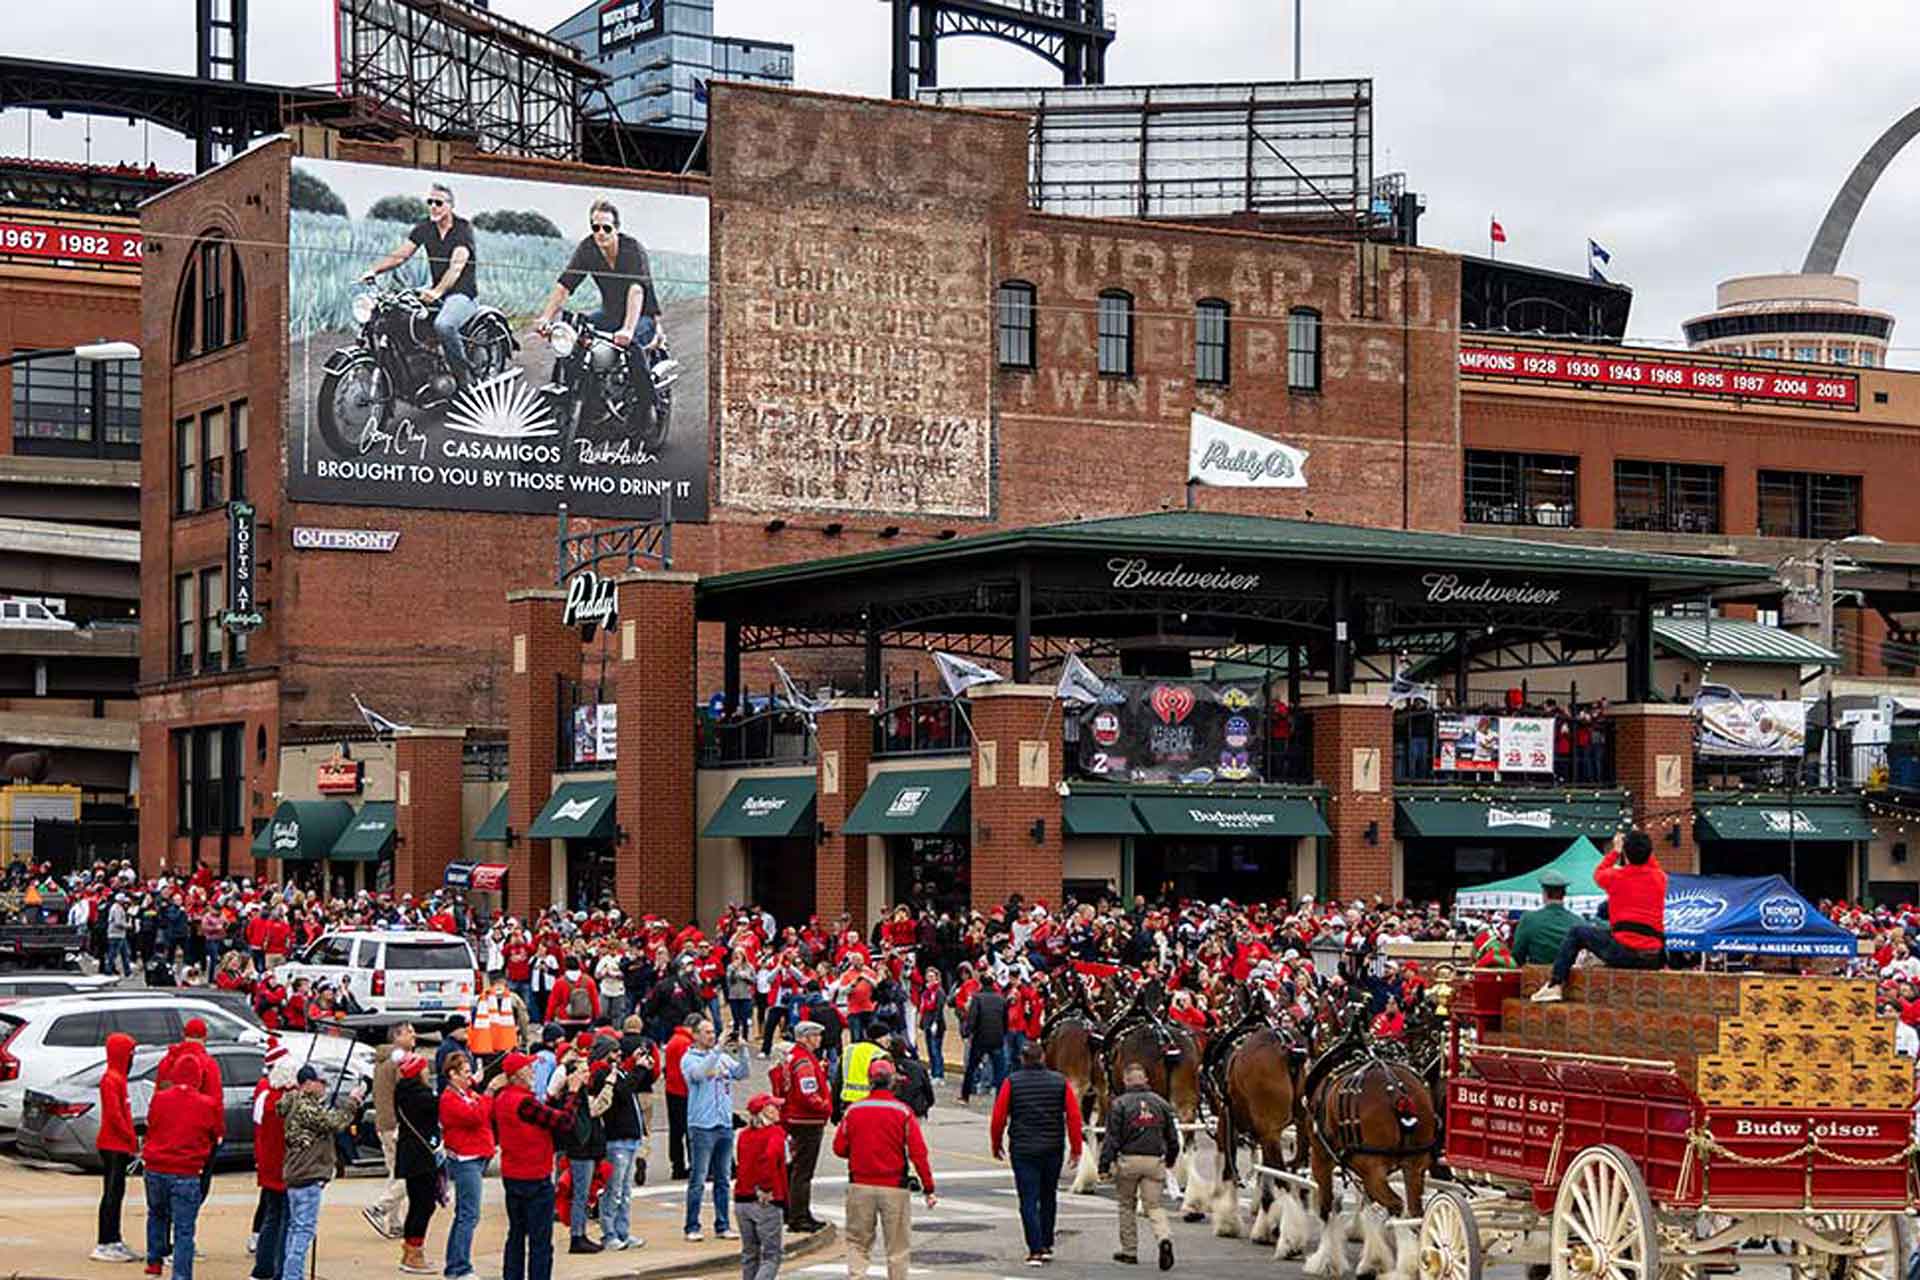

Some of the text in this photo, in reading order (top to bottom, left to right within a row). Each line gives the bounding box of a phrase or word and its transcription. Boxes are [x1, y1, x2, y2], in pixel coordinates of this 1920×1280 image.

[60, 234, 110, 255] 1982
[1523, 357, 1557, 374] 1928
[1566, 361, 1600, 378] 1930
[1608, 365, 1643, 382] 1943
[1650, 368, 1683, 384] 1968
[1692, 371, 1724, 388] 1985
[1732, 374, 1765, 391] 1987
[1773, 379, 1808, 395] 2004
[1816, 383, 1846, 398] 2013
[443, 441, 561, 463] CASAMIGOS
[317, 461, 406, 481] BROUGHT
[409, 466, 434, 483] TO
[439, 468, 478, 486] YOU
[483, 471, 504, 487] BY
[508, 471, 565, 490] THOSE
[569, 475, 615, 494] WHO
[677, 481, 691, 498] IT
[298, 530, 394, 549] OUTFRONT
[237, 518, 250, 610] LOFTS AT
[1106, 557, 1260, 590] Budweiser
[1421, 573, 1561, 604] Budweiser
[1188, 809, 1276, 823] Budweiser
[1760, 943, 1812, 953] AMERICAN
[1813, 944, 1851, 955] VODKA
